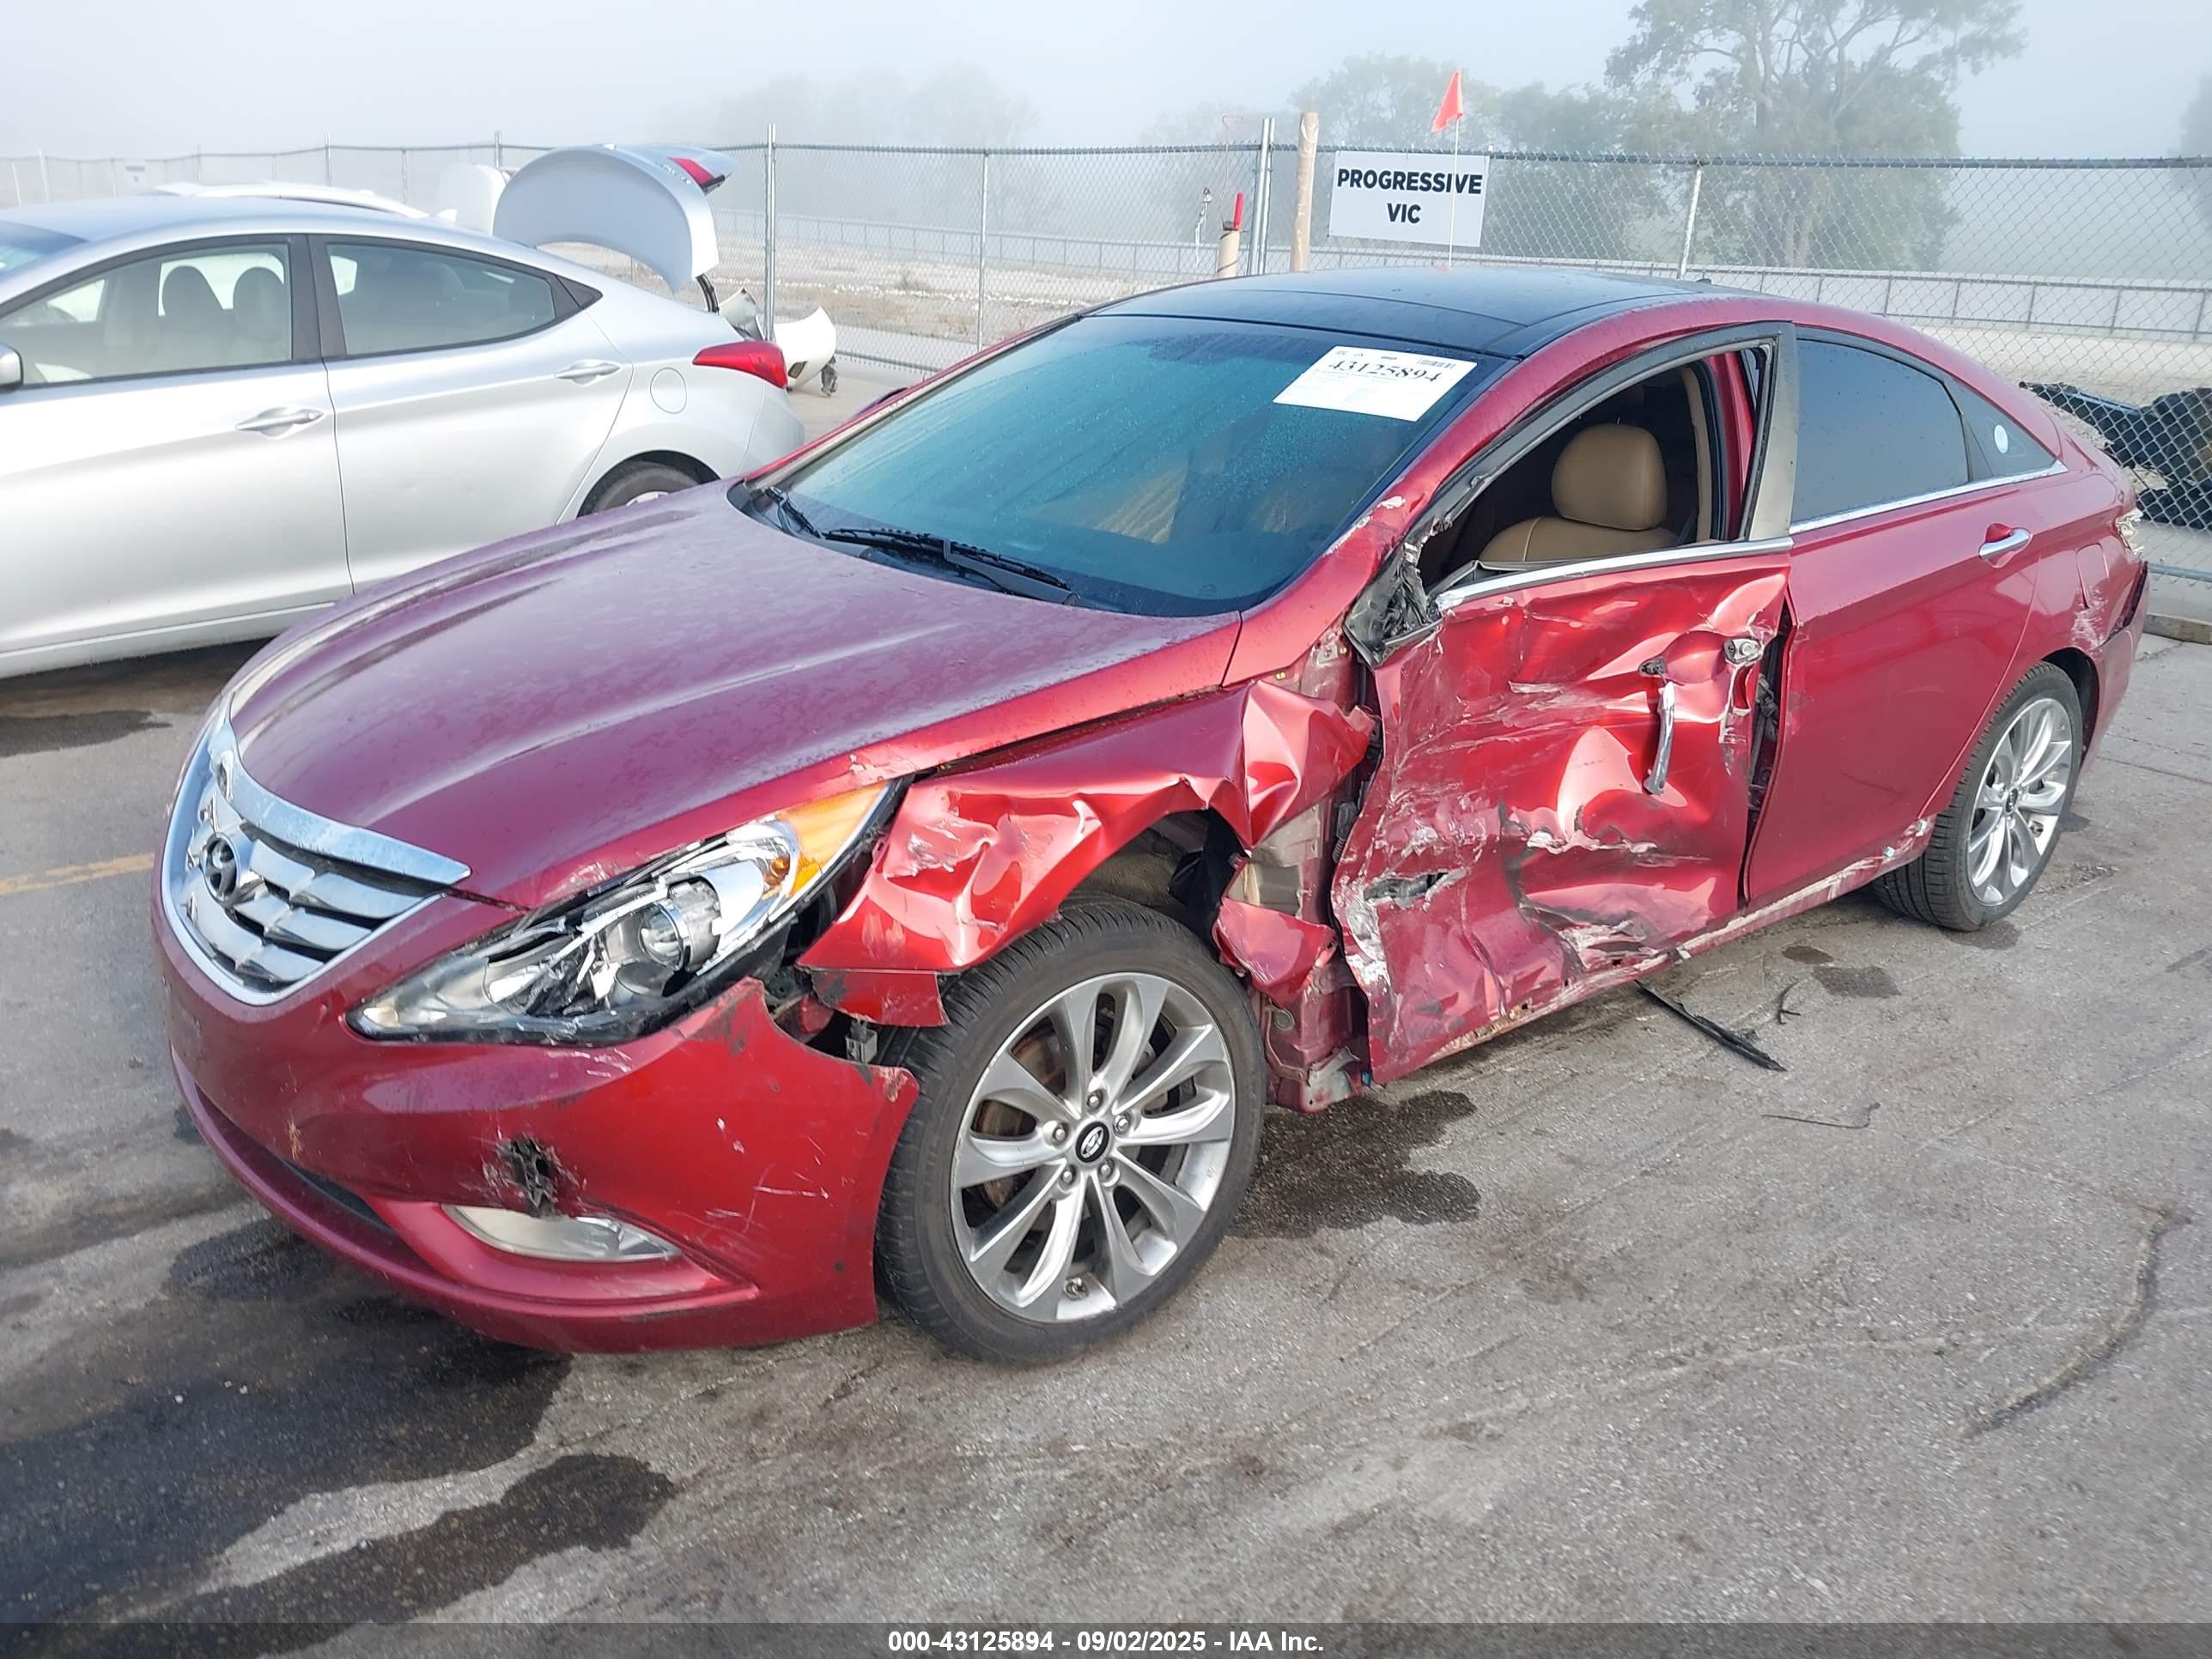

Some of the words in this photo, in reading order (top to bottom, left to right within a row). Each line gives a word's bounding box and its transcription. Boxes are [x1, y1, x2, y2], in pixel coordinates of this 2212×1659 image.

[1337, 168, 1483, 194] PROGRESSIVE
[1387, 203, 1422, 223] VIC
[1328, 359, 1443, 382] 43125894
